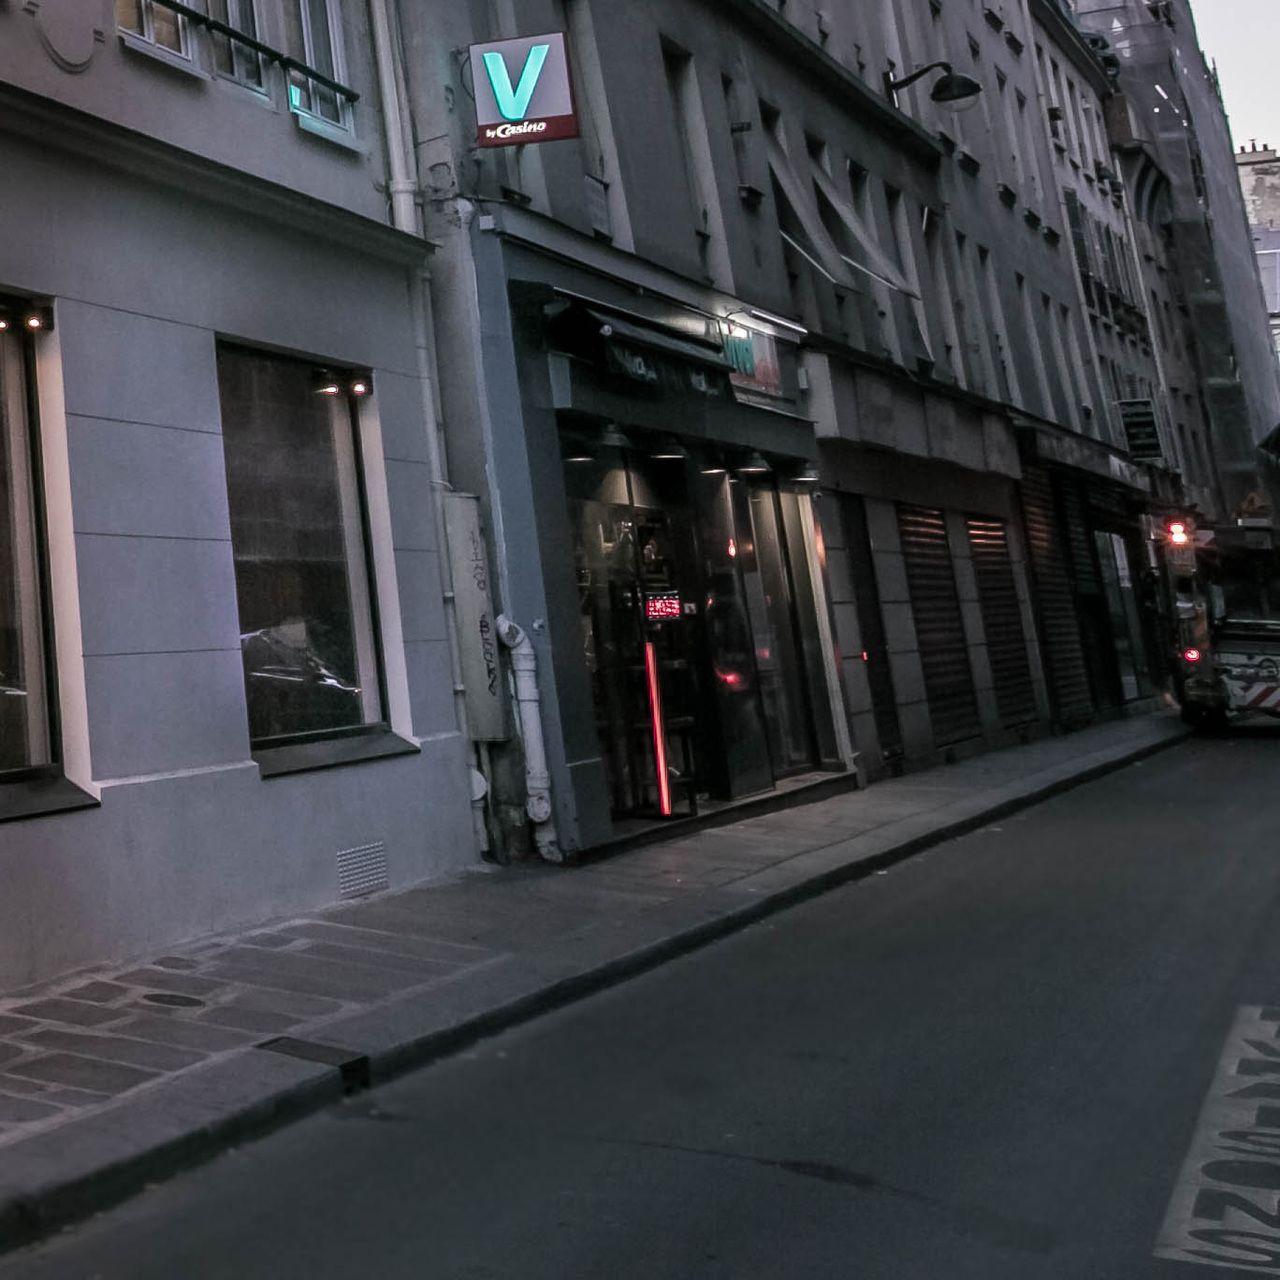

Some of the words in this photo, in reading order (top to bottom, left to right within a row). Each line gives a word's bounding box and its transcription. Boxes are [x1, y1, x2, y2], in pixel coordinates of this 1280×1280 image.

[482, 44, 550, 121] V
[486, 128, 496, 140] by
[496, 121, 547, 139] Casino
